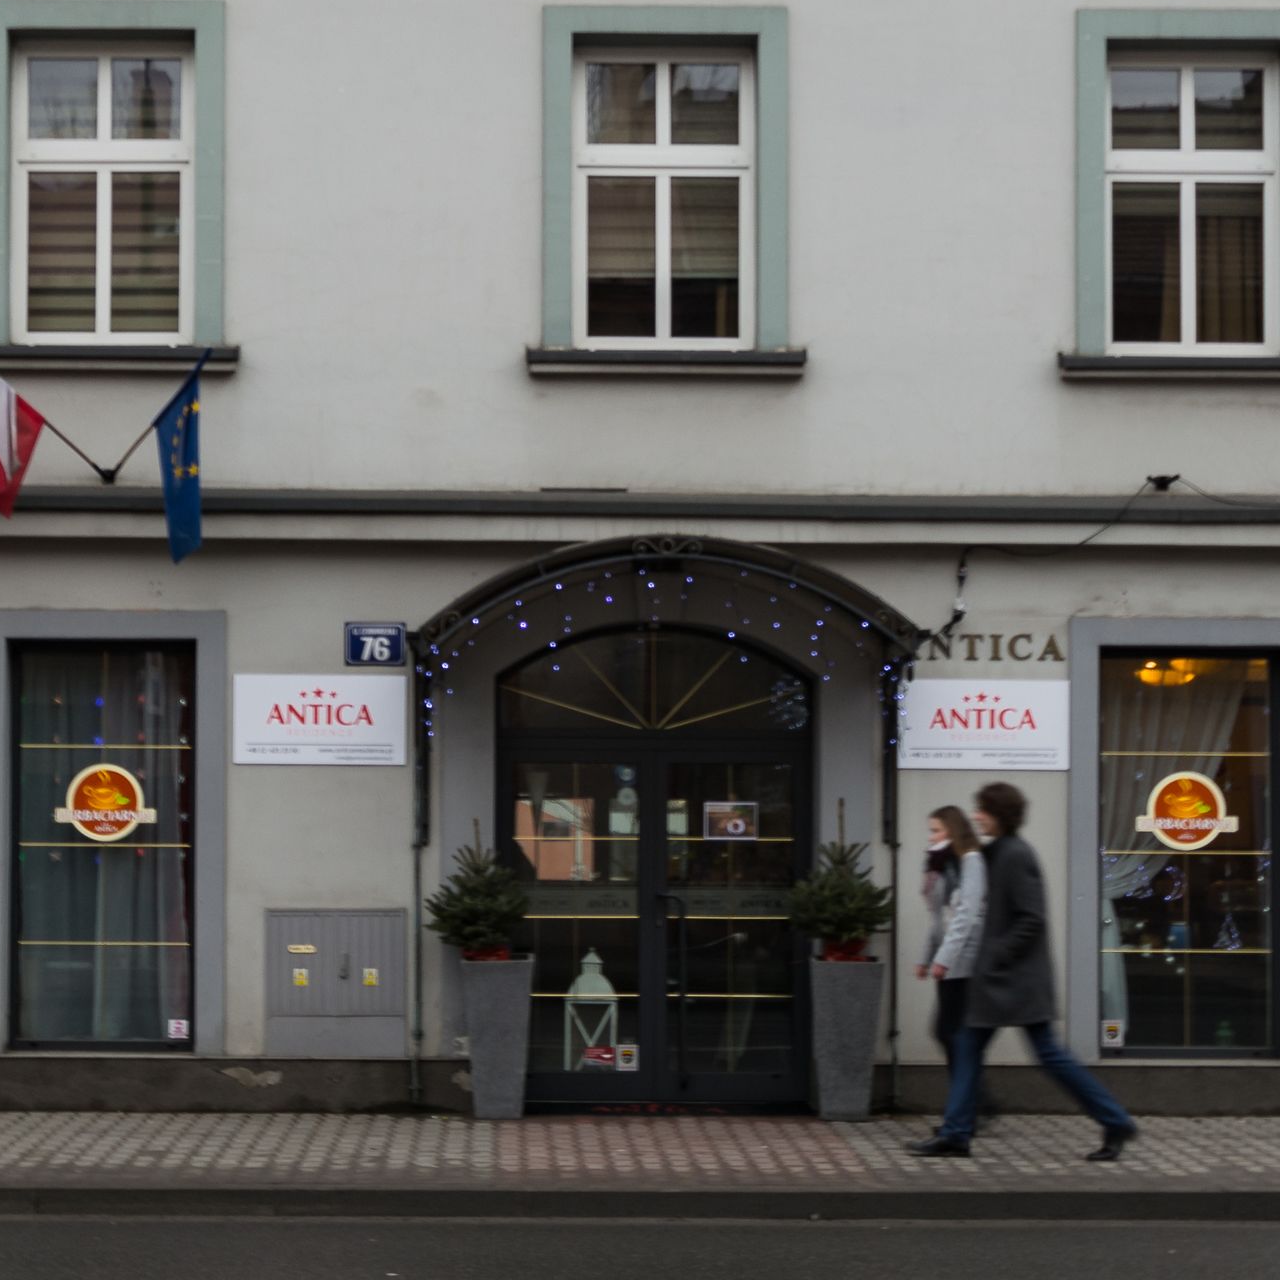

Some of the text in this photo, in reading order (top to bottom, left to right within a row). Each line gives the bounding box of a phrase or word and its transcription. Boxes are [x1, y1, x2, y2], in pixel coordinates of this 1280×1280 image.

[359, 636, 392, 662] 76
[912, 633, 1067, 662] NTICA
[267, 703, 375, 727] ANTICA
[929, 707, 1037, 731] ANTICA
